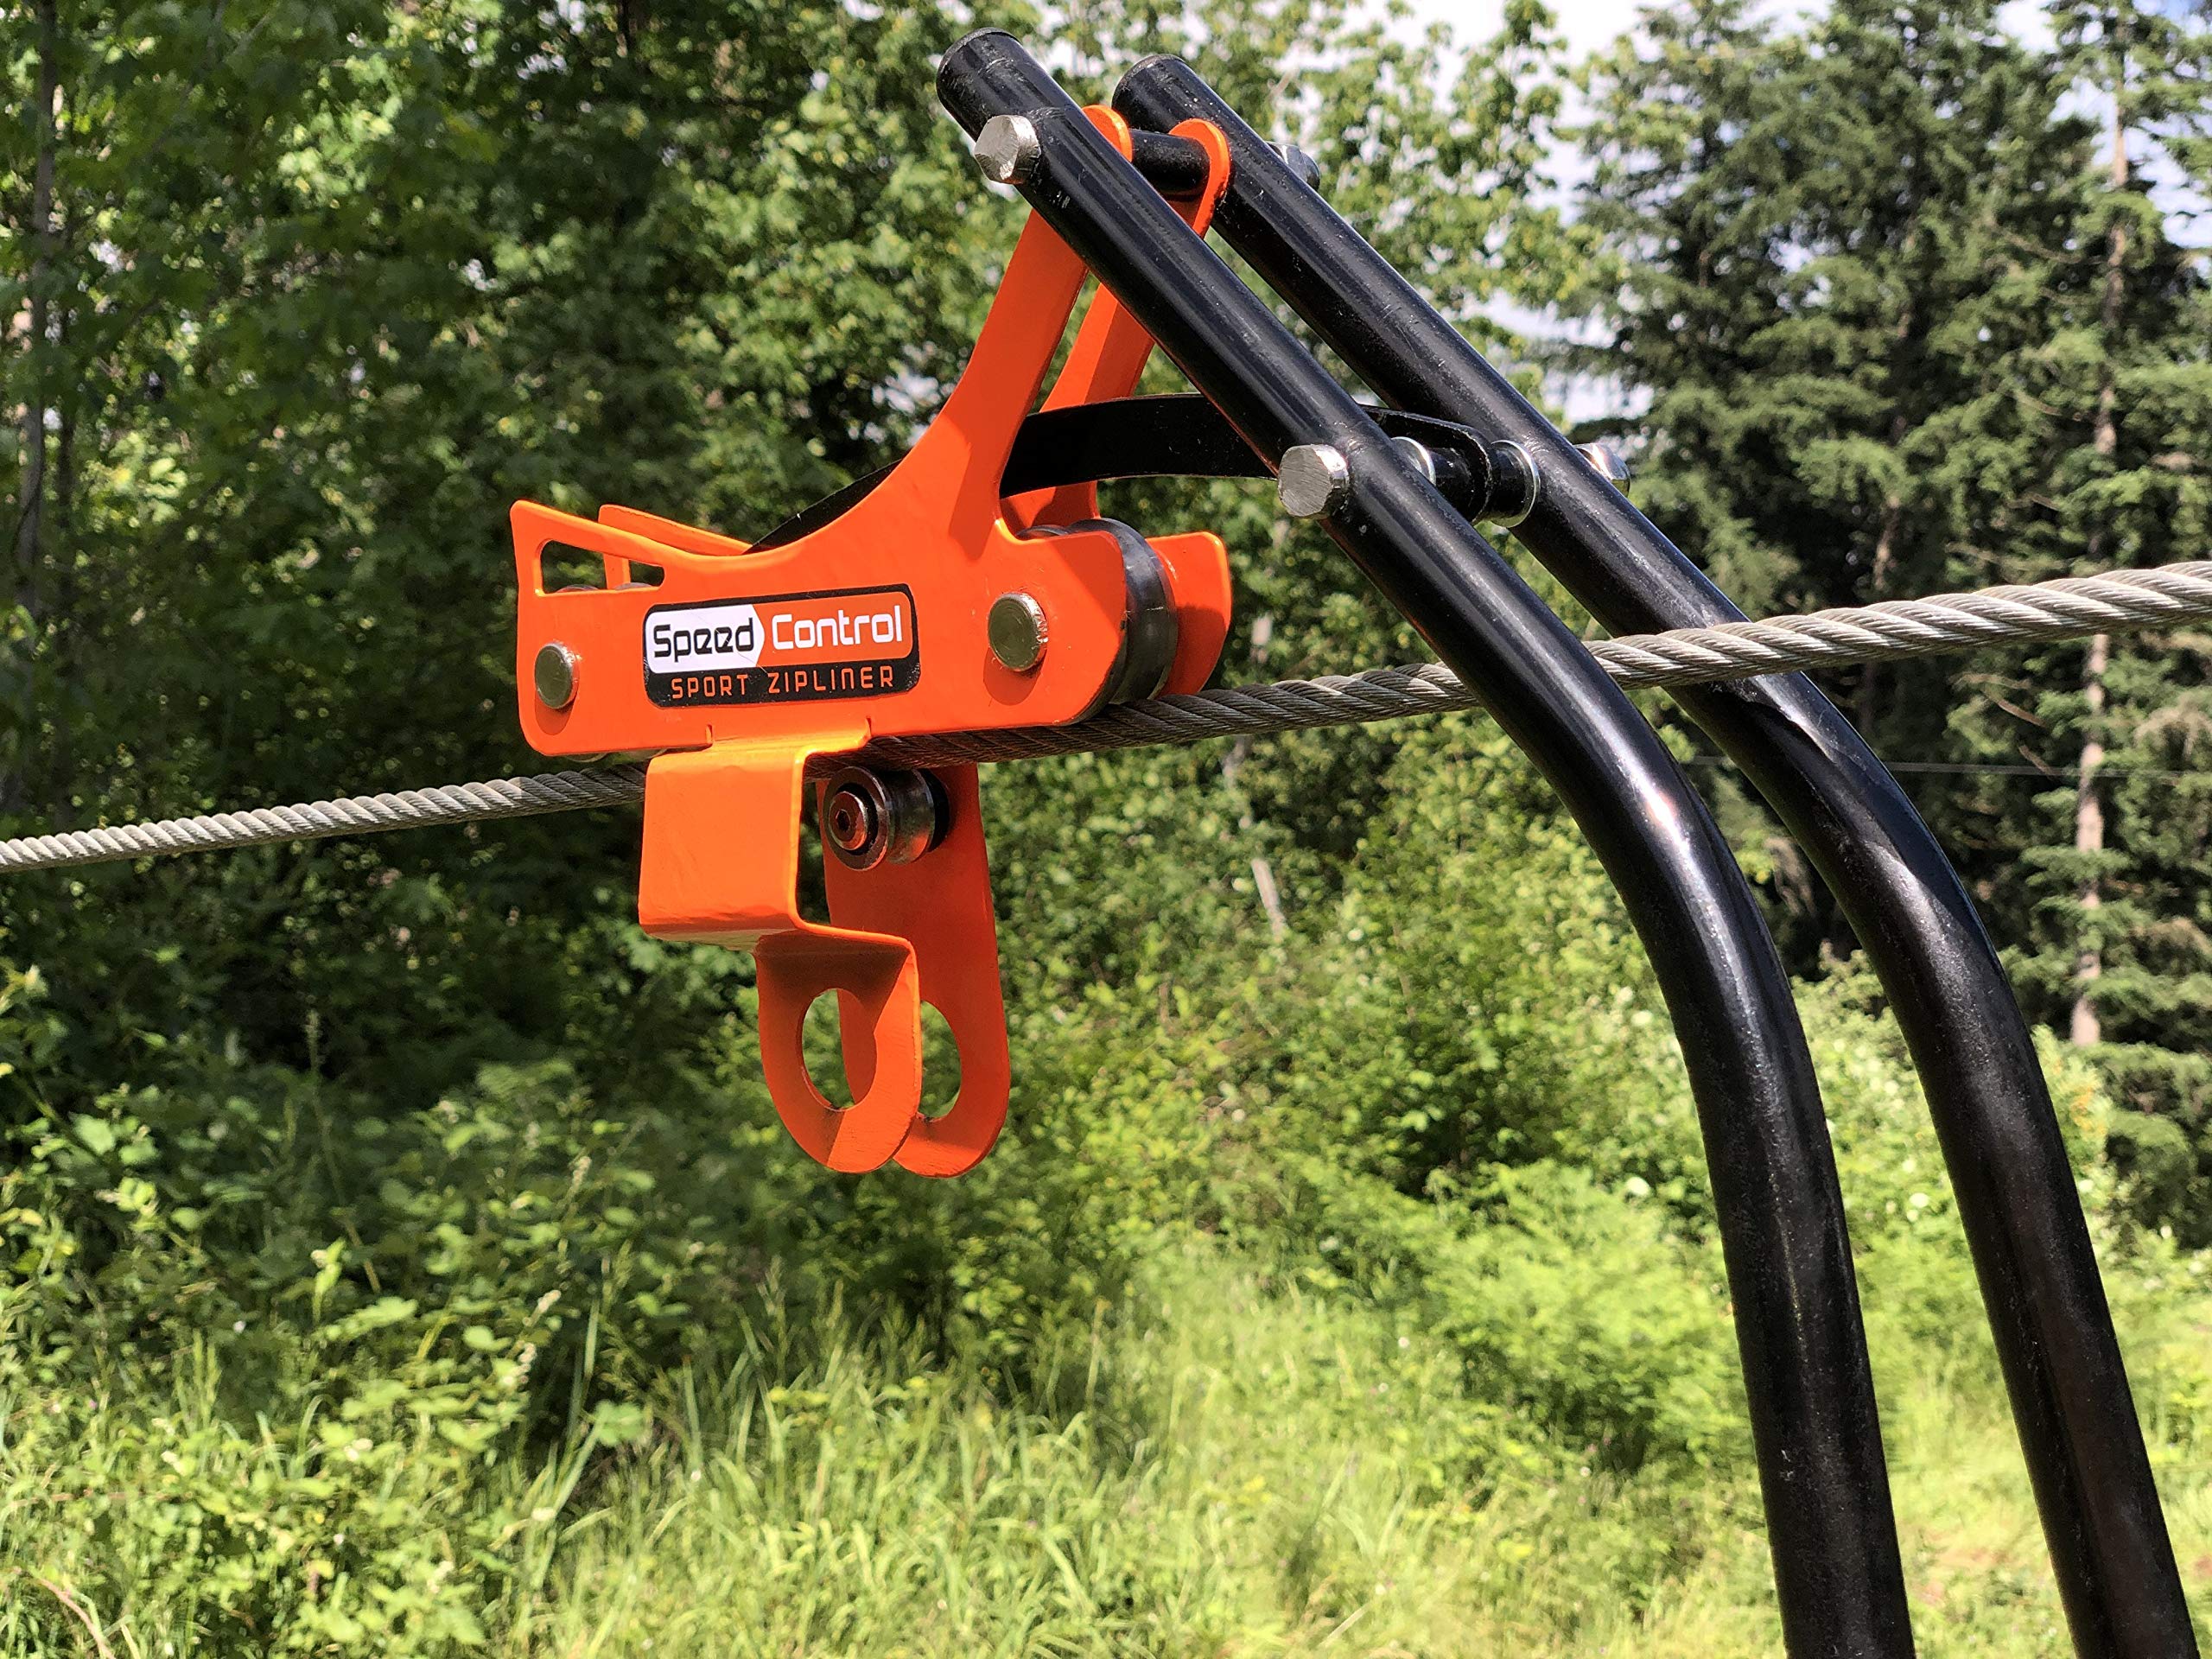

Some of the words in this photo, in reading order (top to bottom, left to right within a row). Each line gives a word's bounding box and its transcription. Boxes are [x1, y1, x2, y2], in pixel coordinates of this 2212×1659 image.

[653, 617, 754, 663] Speed
[772, 605, 902, 650] Control
[671, 674, 748, 699] SPORT
[767, 665, 893, 694] ZIPLINER
